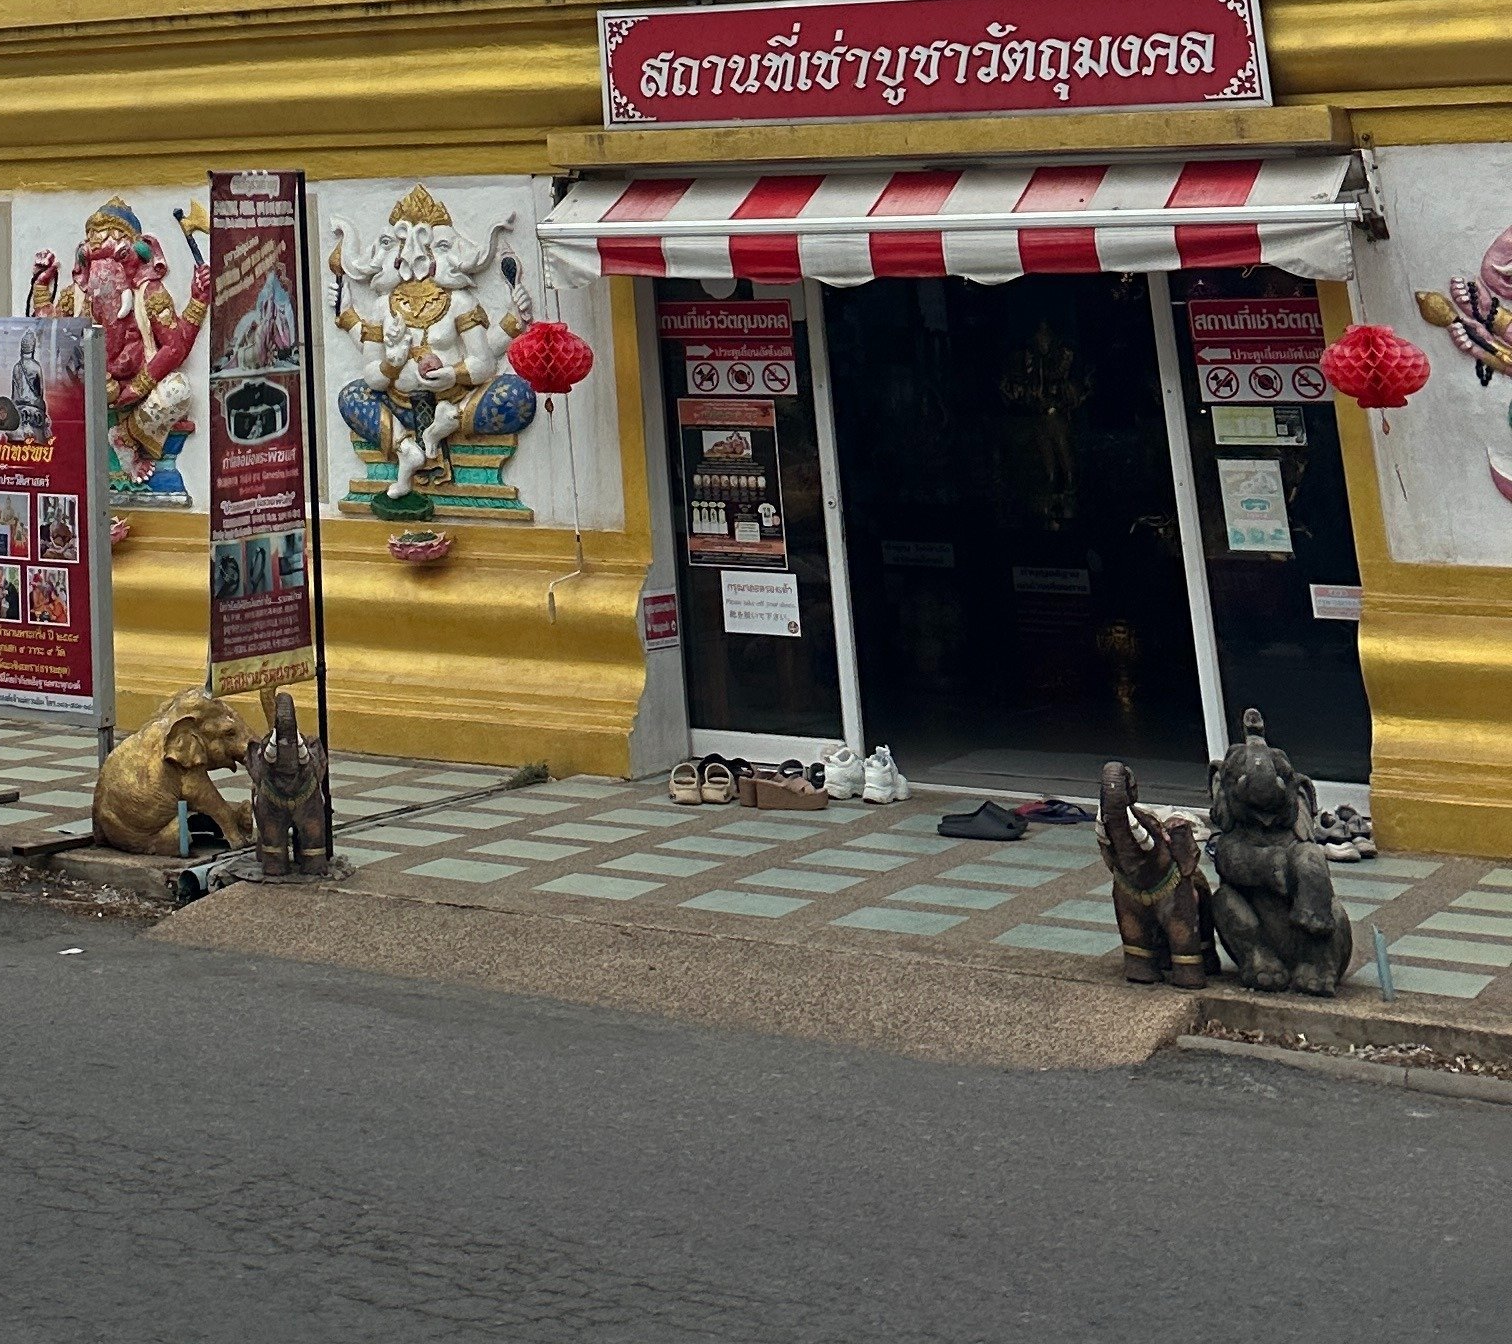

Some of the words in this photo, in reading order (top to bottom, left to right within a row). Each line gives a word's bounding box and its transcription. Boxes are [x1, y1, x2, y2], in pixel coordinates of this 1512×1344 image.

[639, 22, 1216, 105] สถานที่เช่าบูชาวัตถุมงคล
[661, 306, 788, 334] ถานที่เช่าวัตถุมงคล
